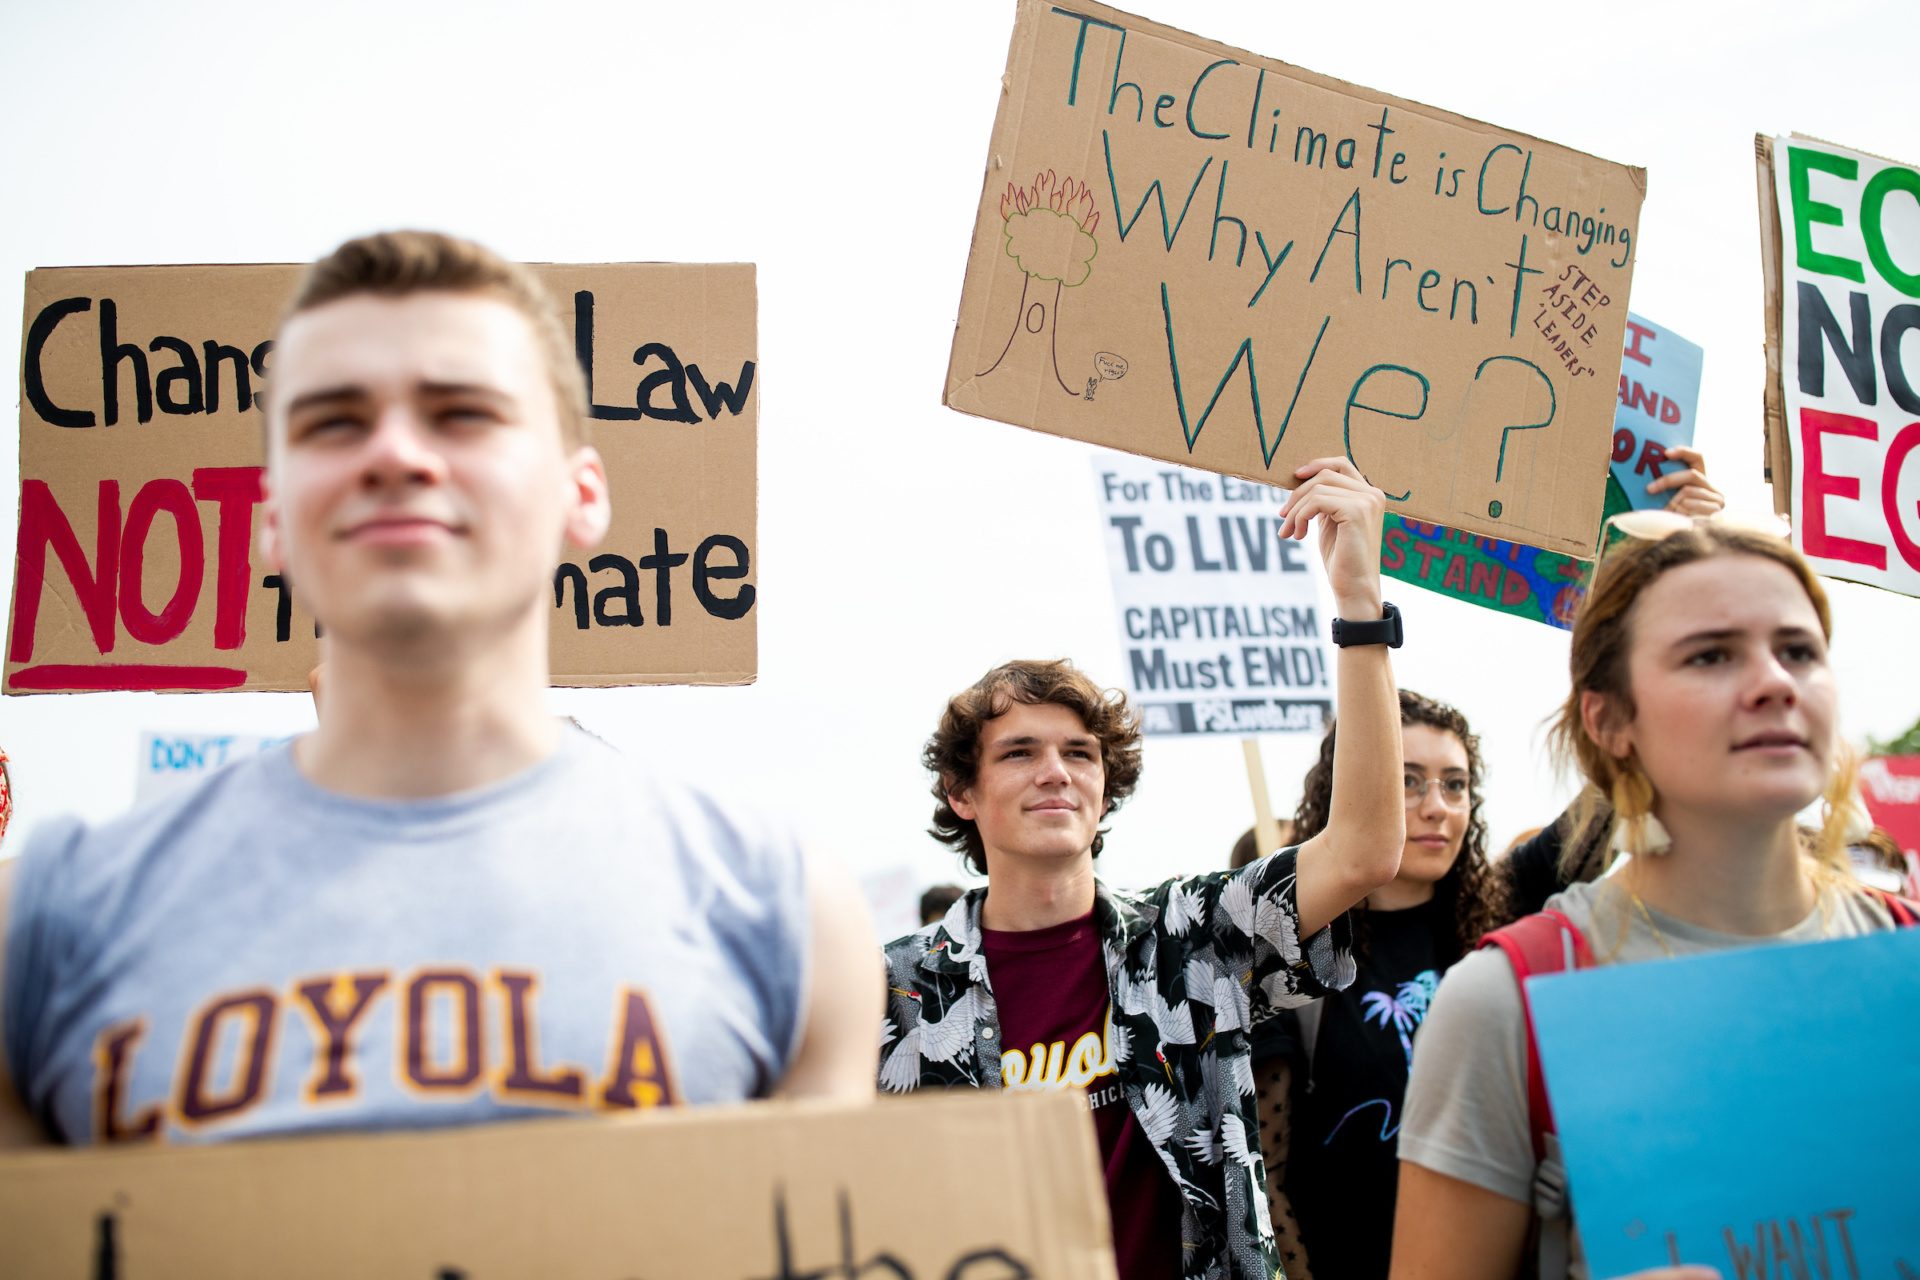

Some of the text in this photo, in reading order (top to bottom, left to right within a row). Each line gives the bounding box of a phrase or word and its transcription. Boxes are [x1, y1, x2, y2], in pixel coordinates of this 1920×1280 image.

[1051, 7, 1631, 268] The Climate is Changing
[1103, 129, 1544, 338] Why Aren't
[1559, 264, 1611, 312] STEP
[575, 290, 756, 424] Law
[1618, 374, 1681, 425] AND
[1612, 428, 1668, 479] OR
[1102, 473, 1151, 501] For
[1157, 473, 1213, 502] The
[10, 466, 268, 664] NOT
[1110, 515, 1307, 573] To LIVE
[1382, 528, 1530, 606] STAND
[1125, 606, 1318, 640] CAPITALISM
[1129, 646, 1328, 690] Must END!
[93, 962, 680, 1146] LOYOLA
[1722, 1208, 1860, 1280] WANT
